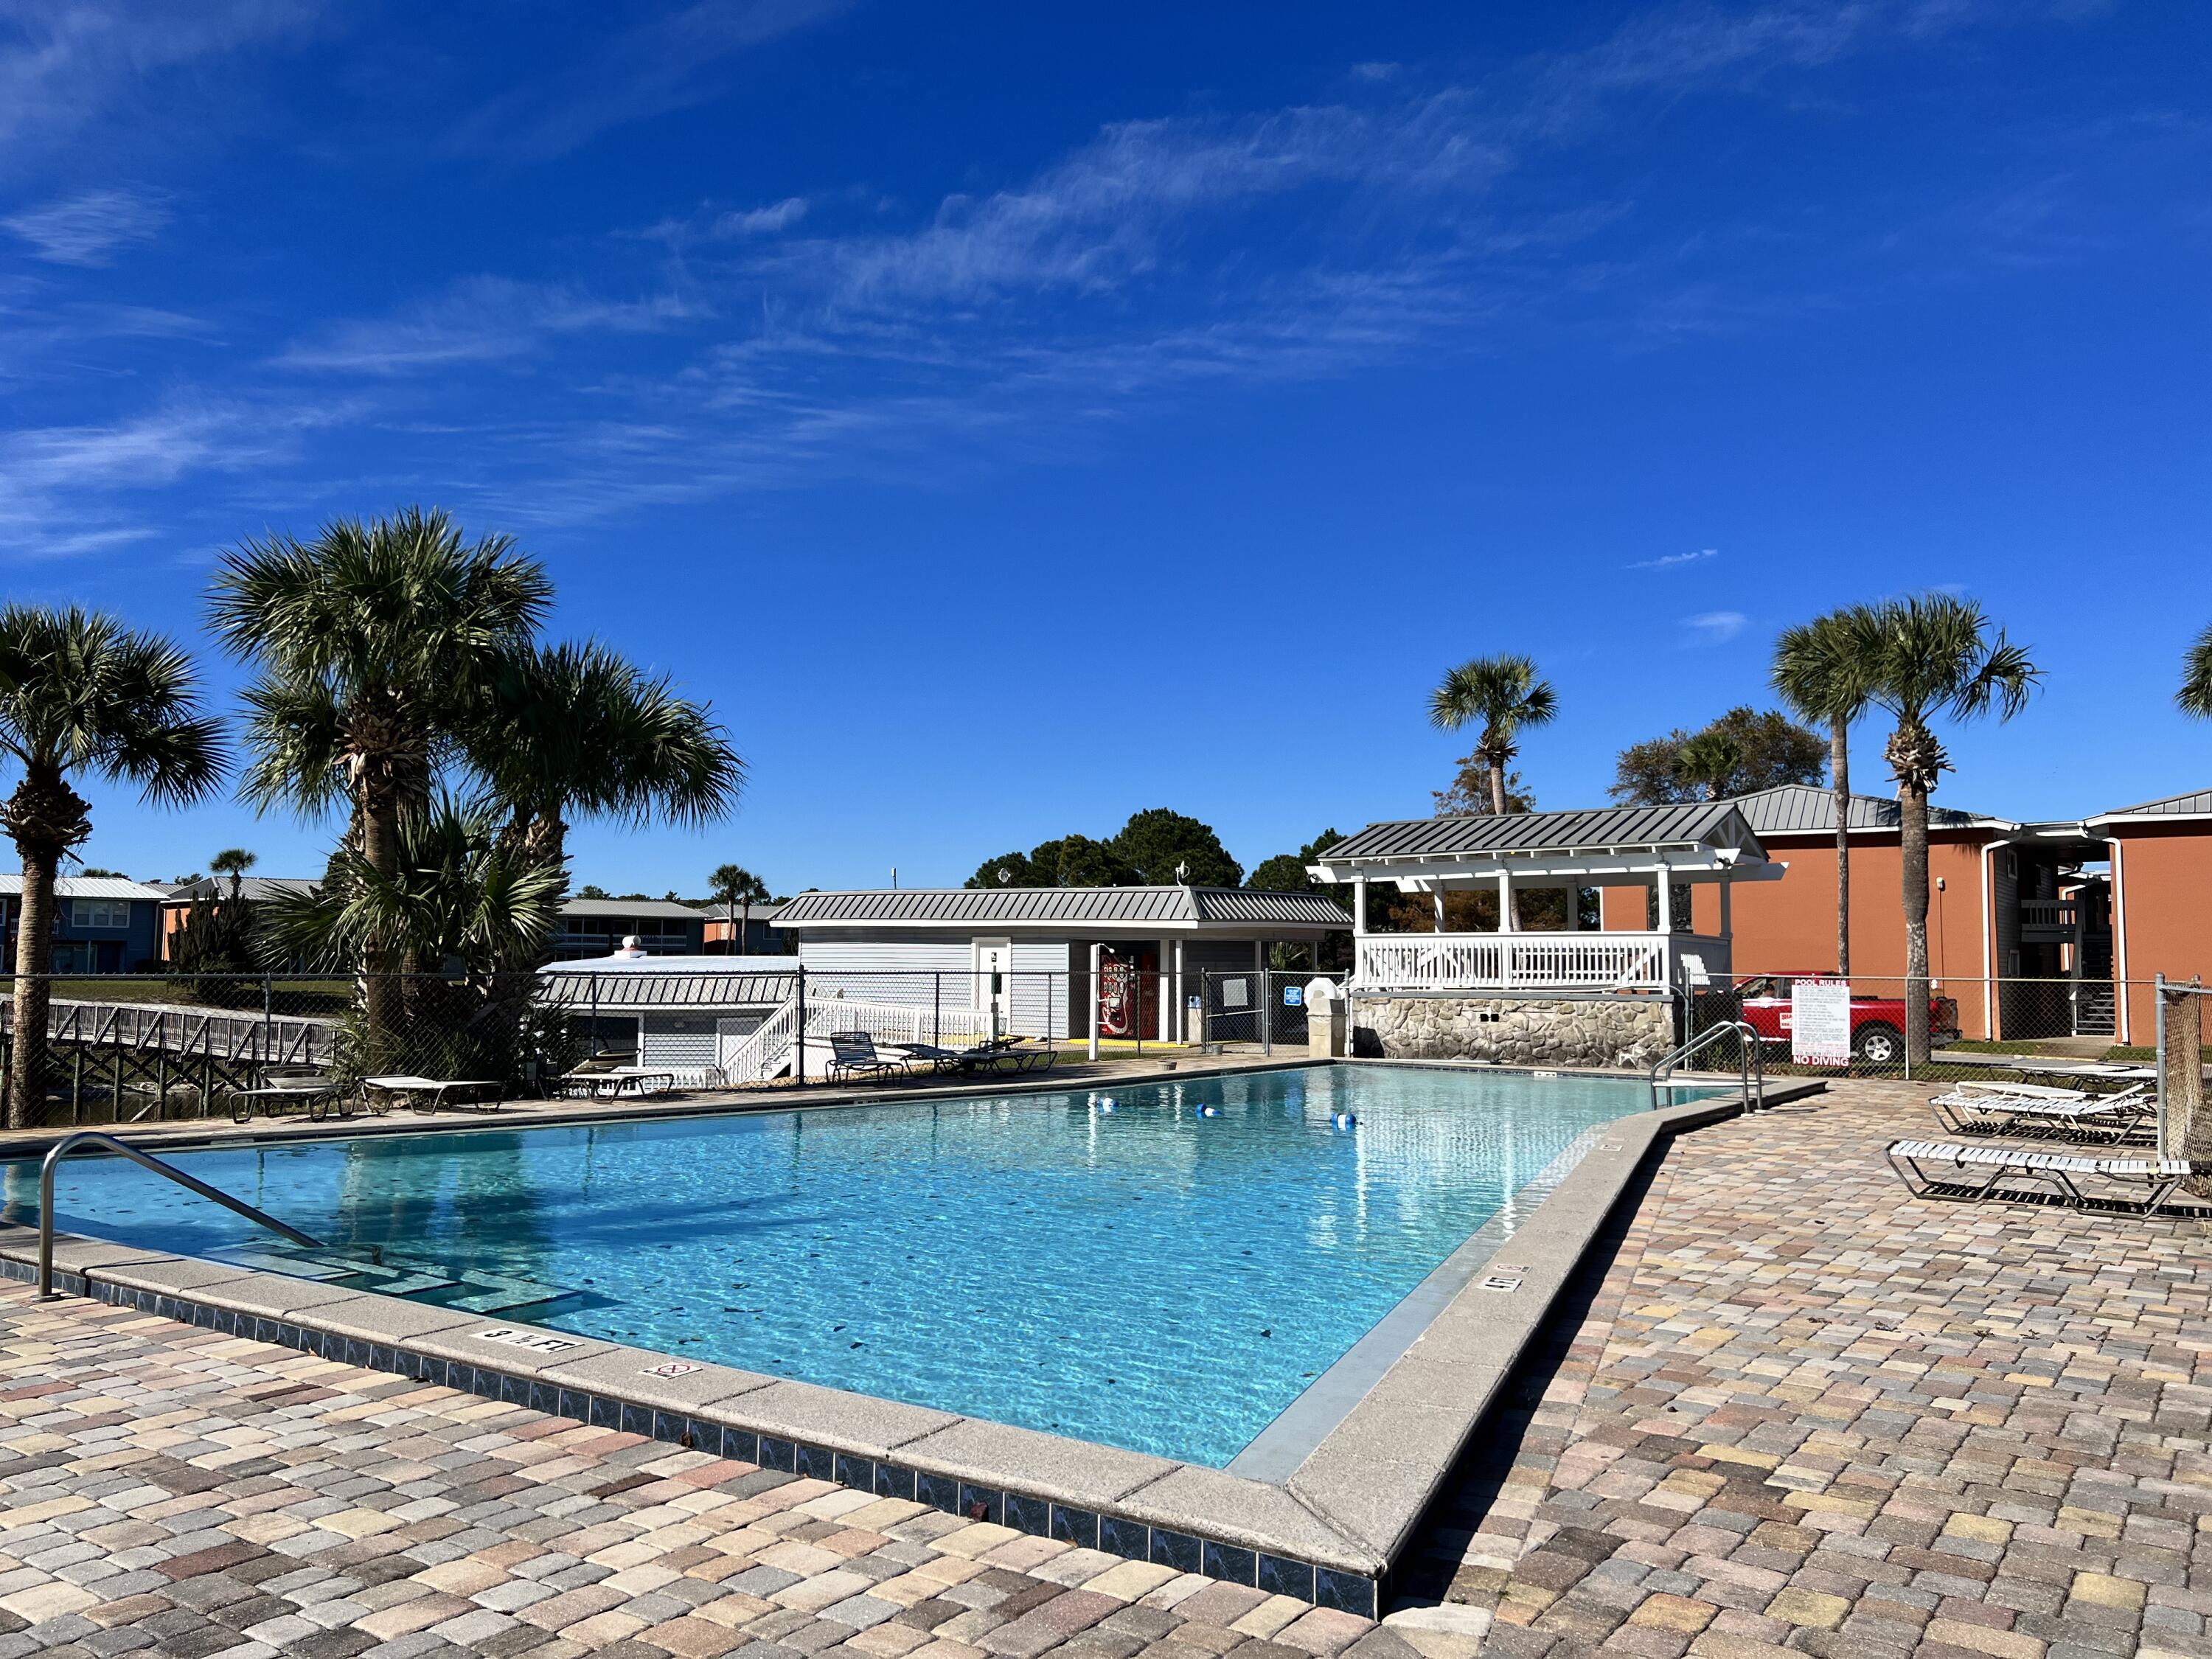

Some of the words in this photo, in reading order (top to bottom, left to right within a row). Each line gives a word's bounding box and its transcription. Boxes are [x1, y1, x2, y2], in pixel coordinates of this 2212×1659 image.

[1793, 1055, 1809, 1065] NO
[1812, 1057, 1849, 1067] DIVING
[531, 1340, 576, 1351] FT
